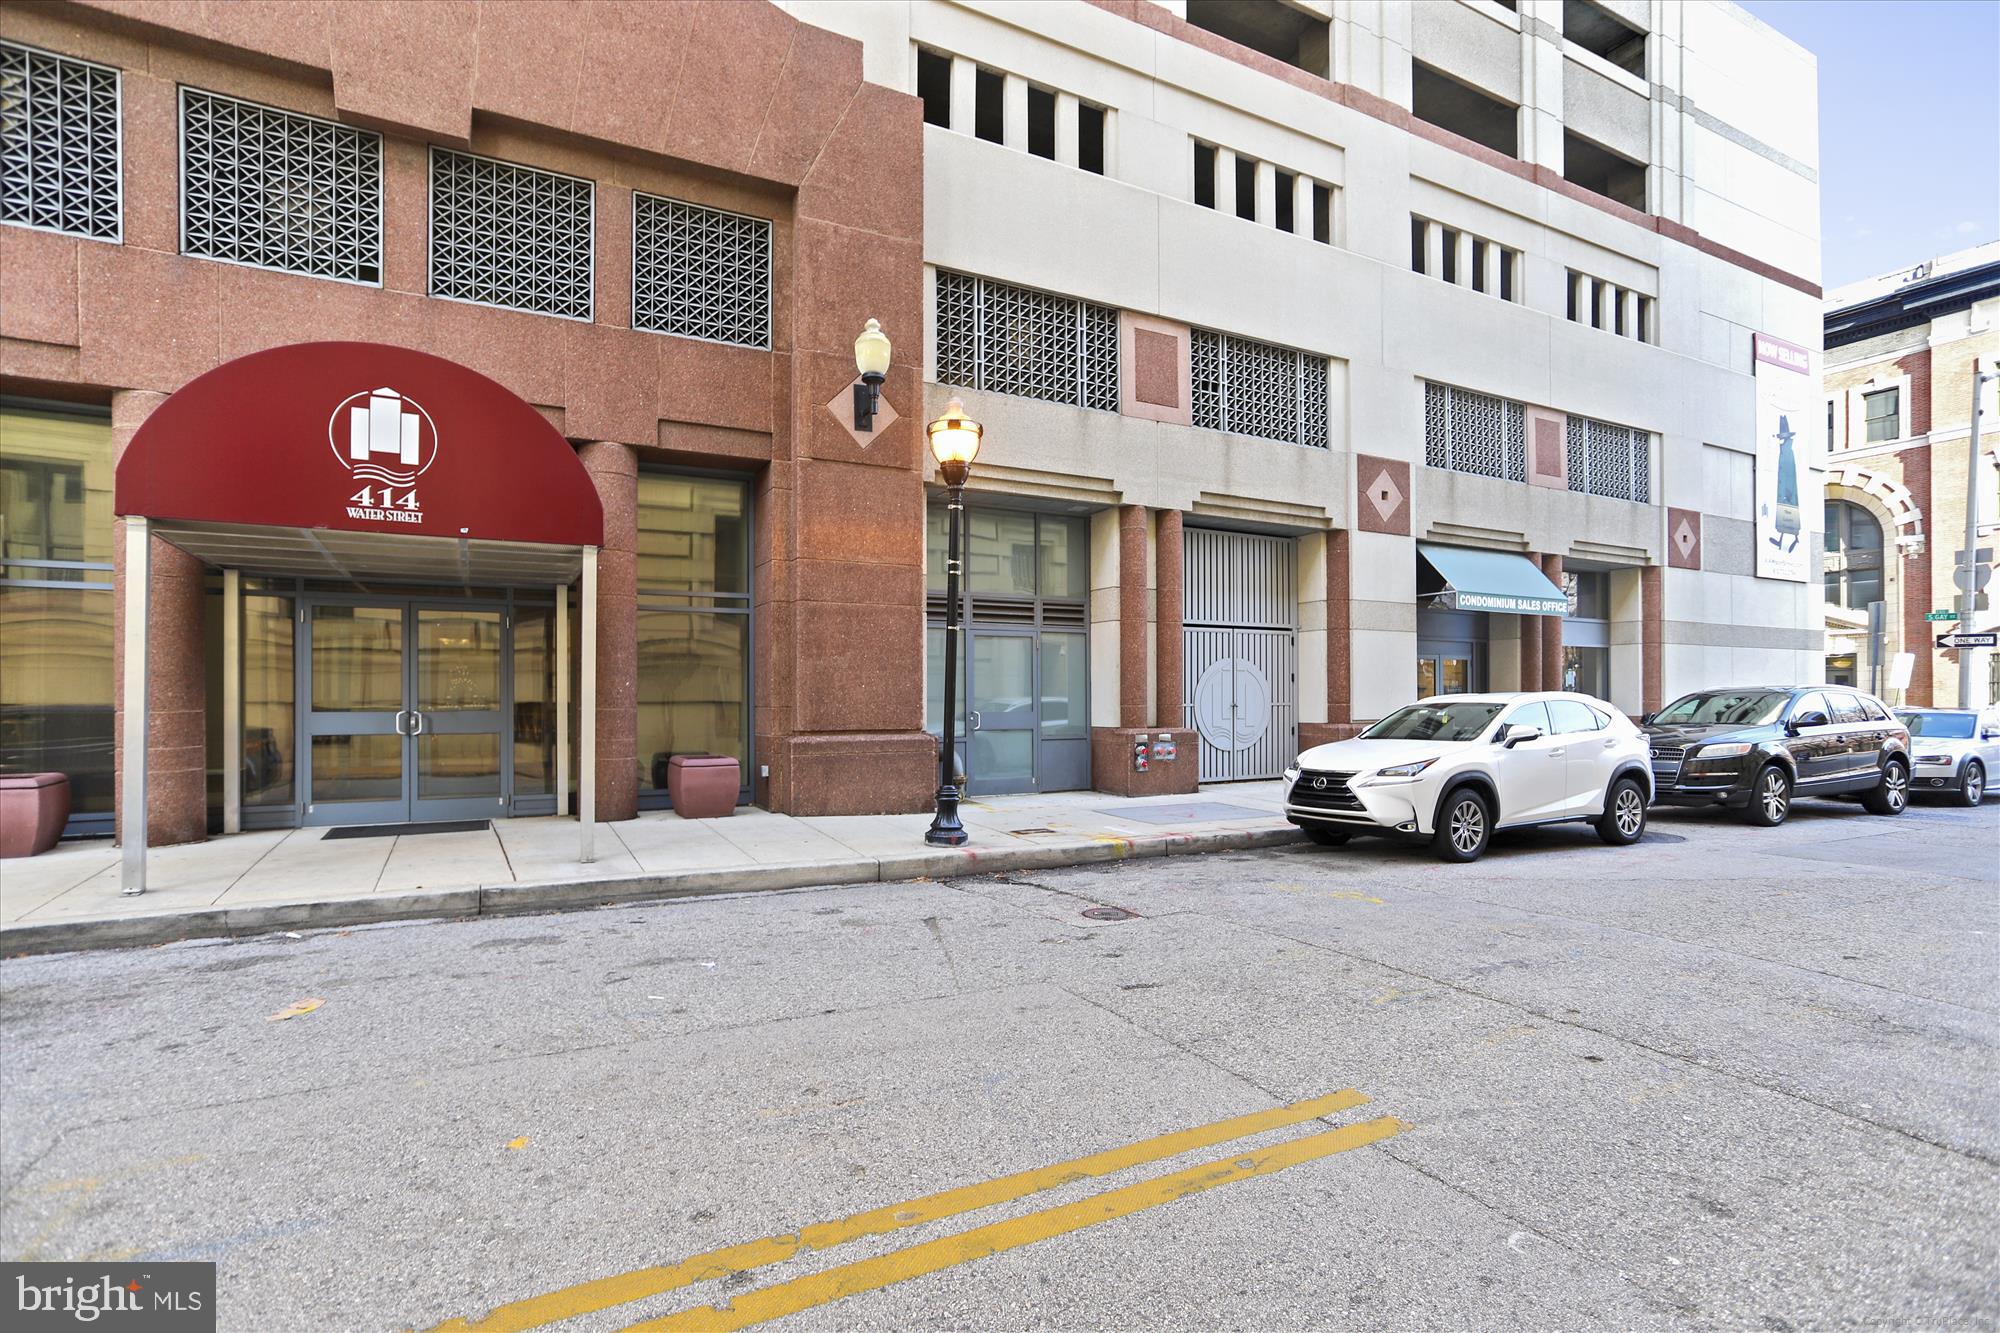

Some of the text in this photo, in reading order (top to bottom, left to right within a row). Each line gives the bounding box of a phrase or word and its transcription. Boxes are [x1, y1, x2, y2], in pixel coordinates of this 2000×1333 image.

[349, 485, 420, 510] 414
[346, 506, 423, 523] WATER STREET
[1459, 595, 1567, 613] CONDOMINIUM SALES OFFICE
